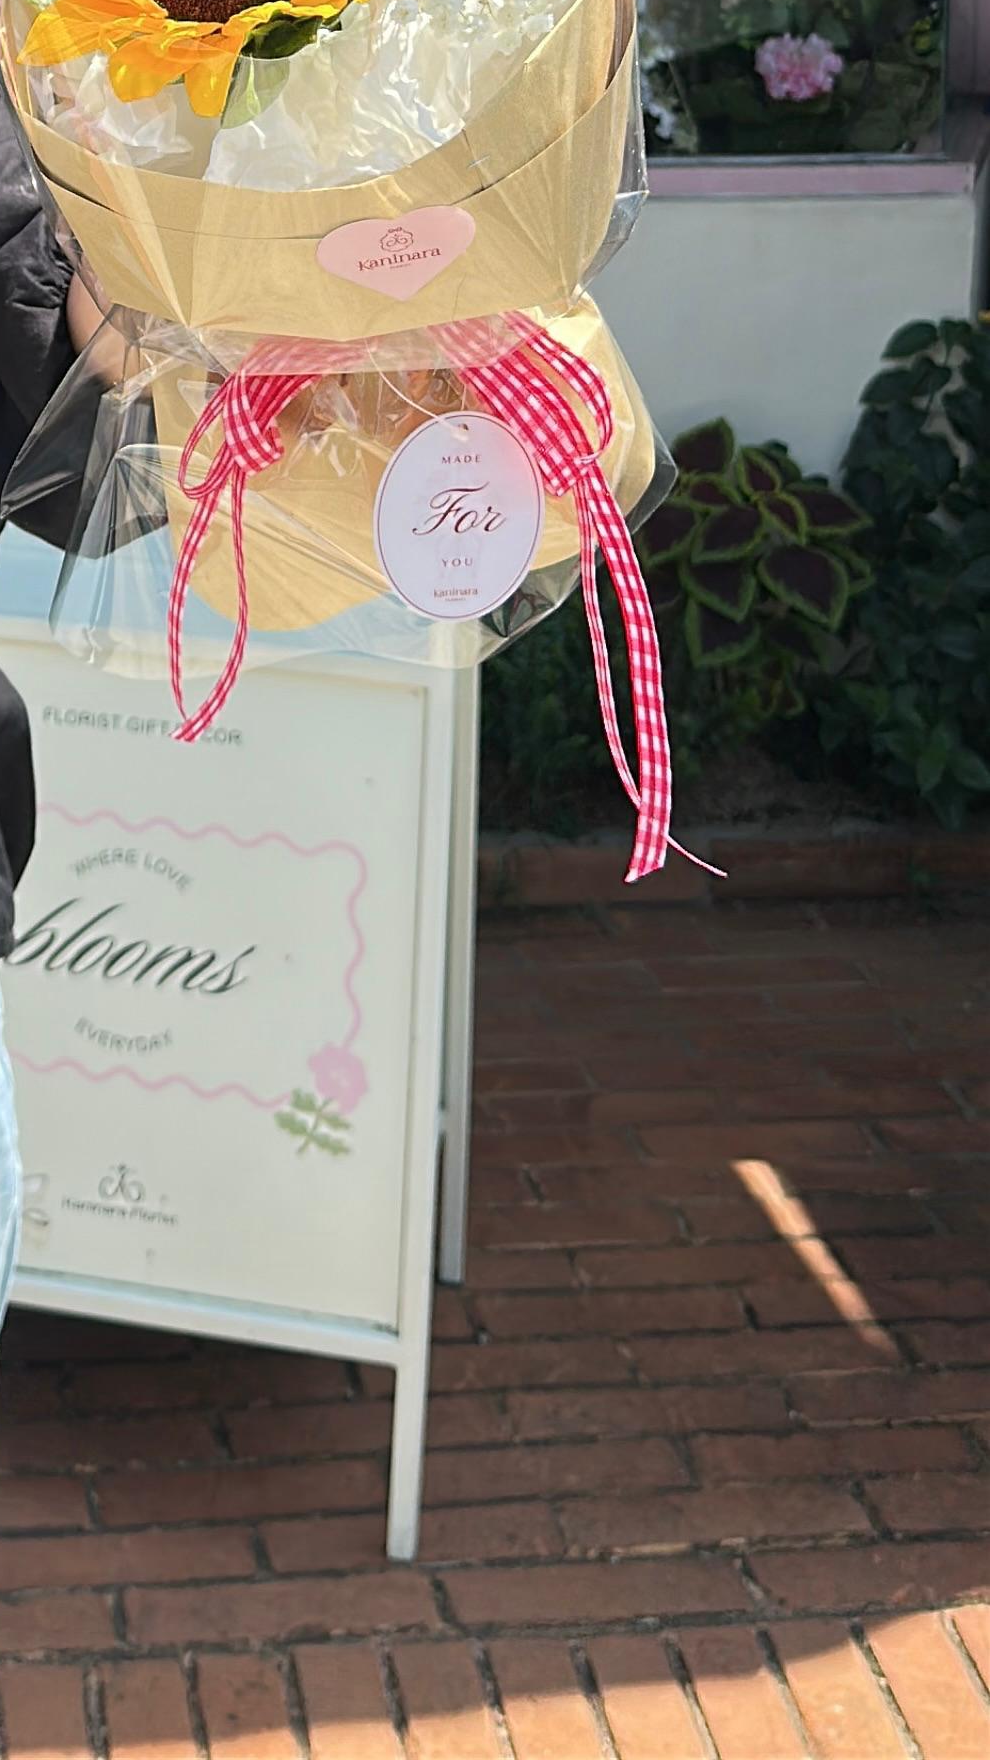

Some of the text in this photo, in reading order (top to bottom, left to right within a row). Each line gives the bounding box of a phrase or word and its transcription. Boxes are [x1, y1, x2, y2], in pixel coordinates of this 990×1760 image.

[441, 454, 483, 465] MADE
[412, 481, 507, 537] For
[441, 558, 474, 568] YOU
[42, 705, 121, 729] FLORIST
[72, 847, 194, 891] WHERE LOVE
[4, 896, 257, 995] blooms
